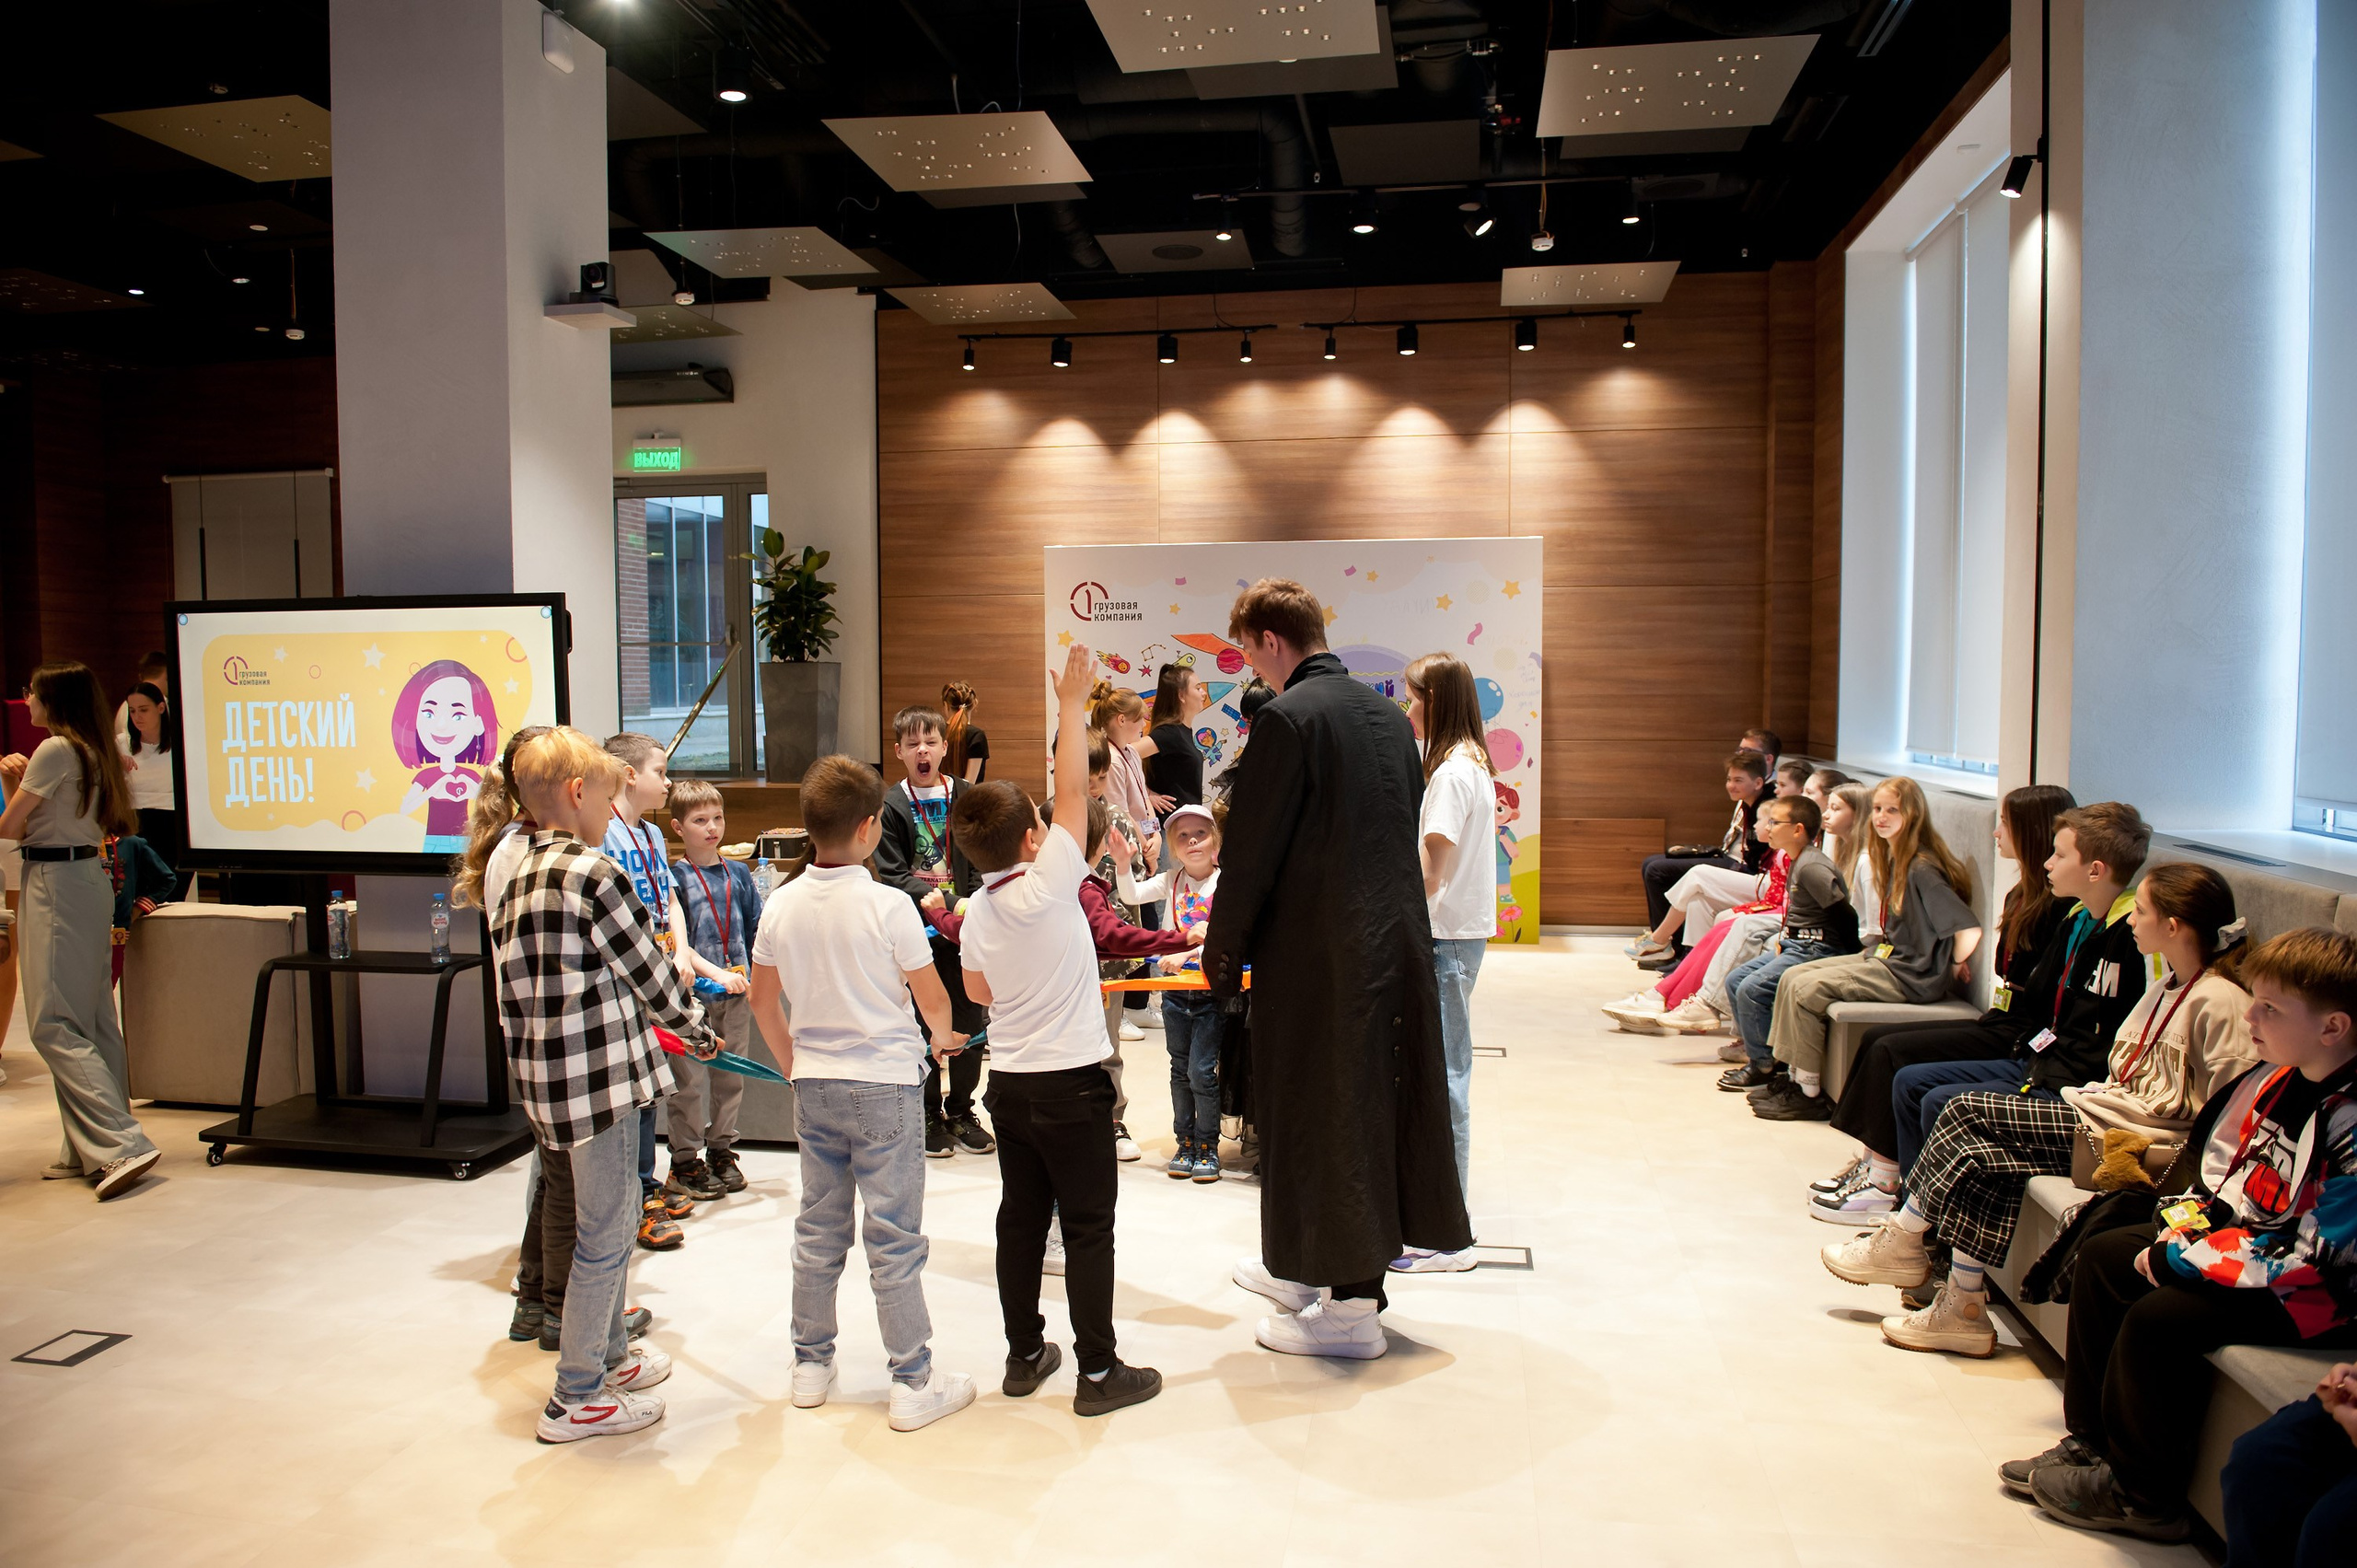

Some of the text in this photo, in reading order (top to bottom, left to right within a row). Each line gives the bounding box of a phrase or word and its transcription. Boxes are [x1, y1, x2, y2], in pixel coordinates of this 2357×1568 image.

[633, 451, 679, 470] ВЫХОД
[1094, 601, 1138, 612] грузовая
[1094, 613, 1143, 621] компания
[222, 692, 356, 753] ДЕТСКИЙ
[226, 756, 315, 807] ДЕНЬ!
